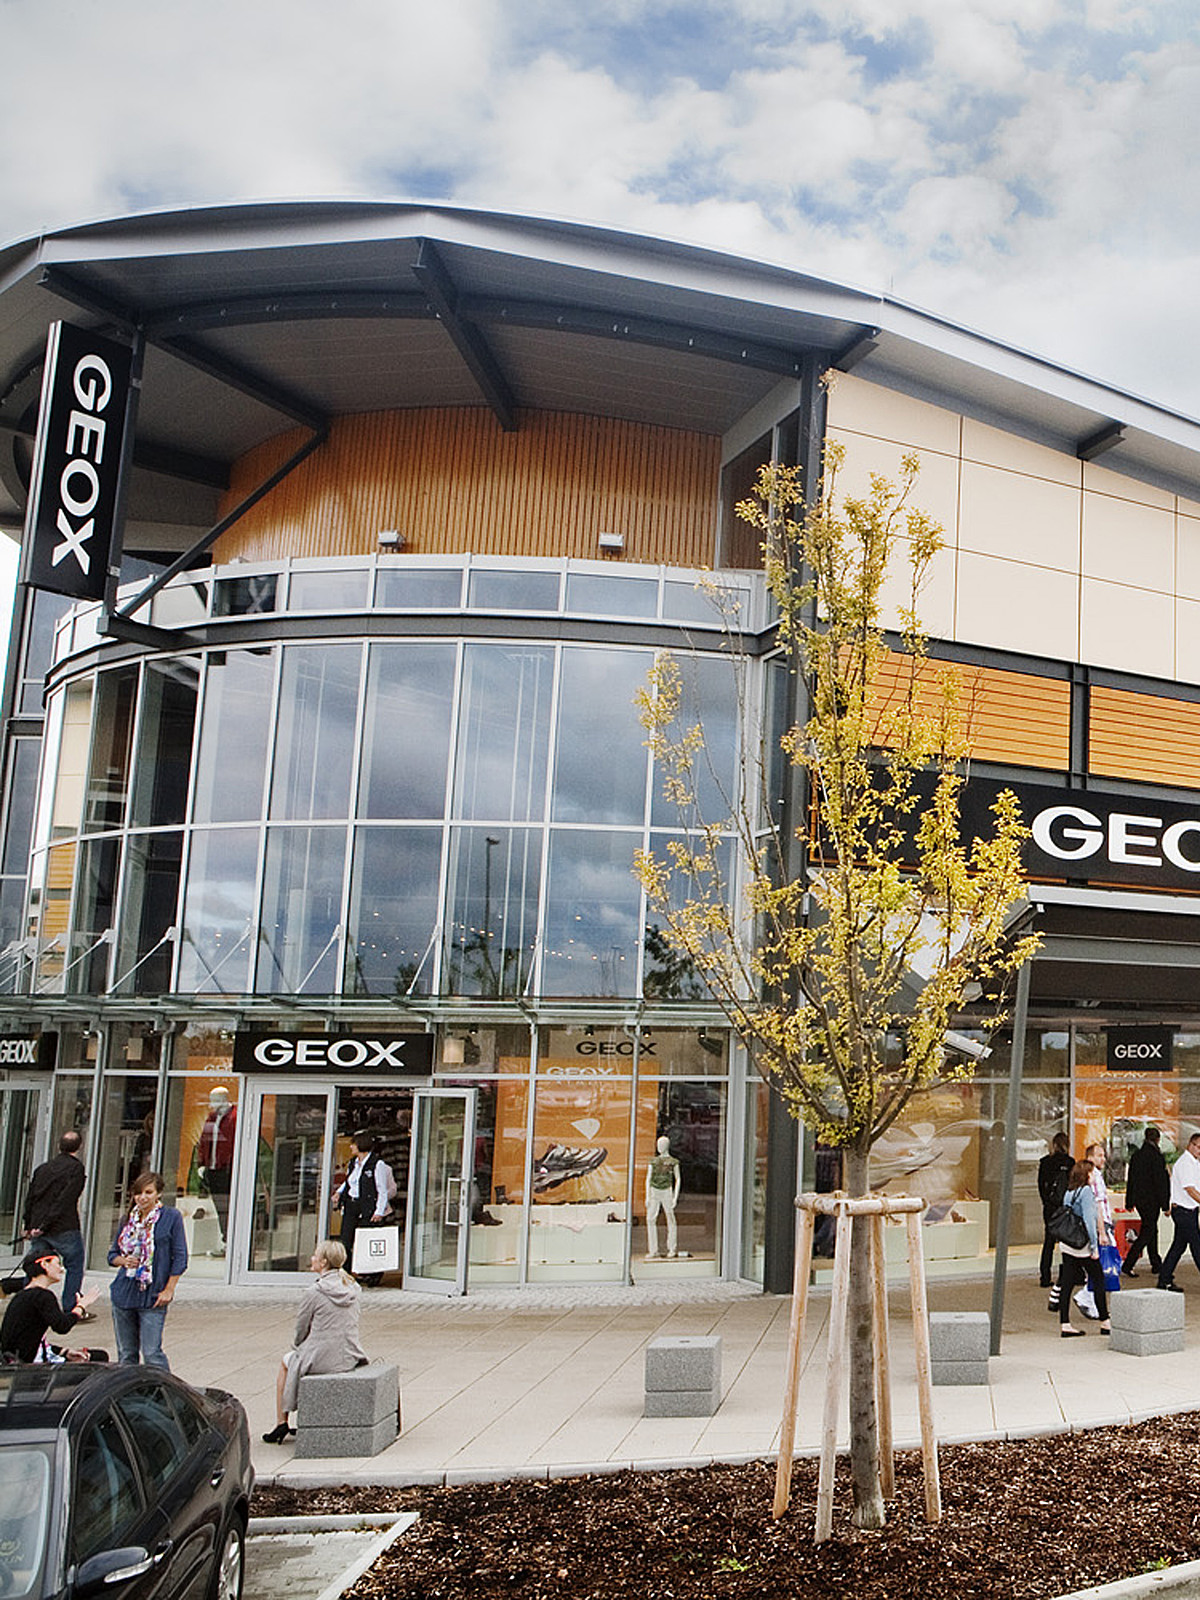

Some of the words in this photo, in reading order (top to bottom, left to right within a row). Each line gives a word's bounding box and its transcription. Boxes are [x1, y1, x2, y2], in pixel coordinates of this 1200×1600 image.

[51, 354, 112, 576] GEOX
[0, 1039, 37, 1064] GEOX
[254, 1039, 406, 1067] GEOX
[575, 1041, 657, 1055] GEOX
[1114, 1044, 1163, 1059] GEOX
